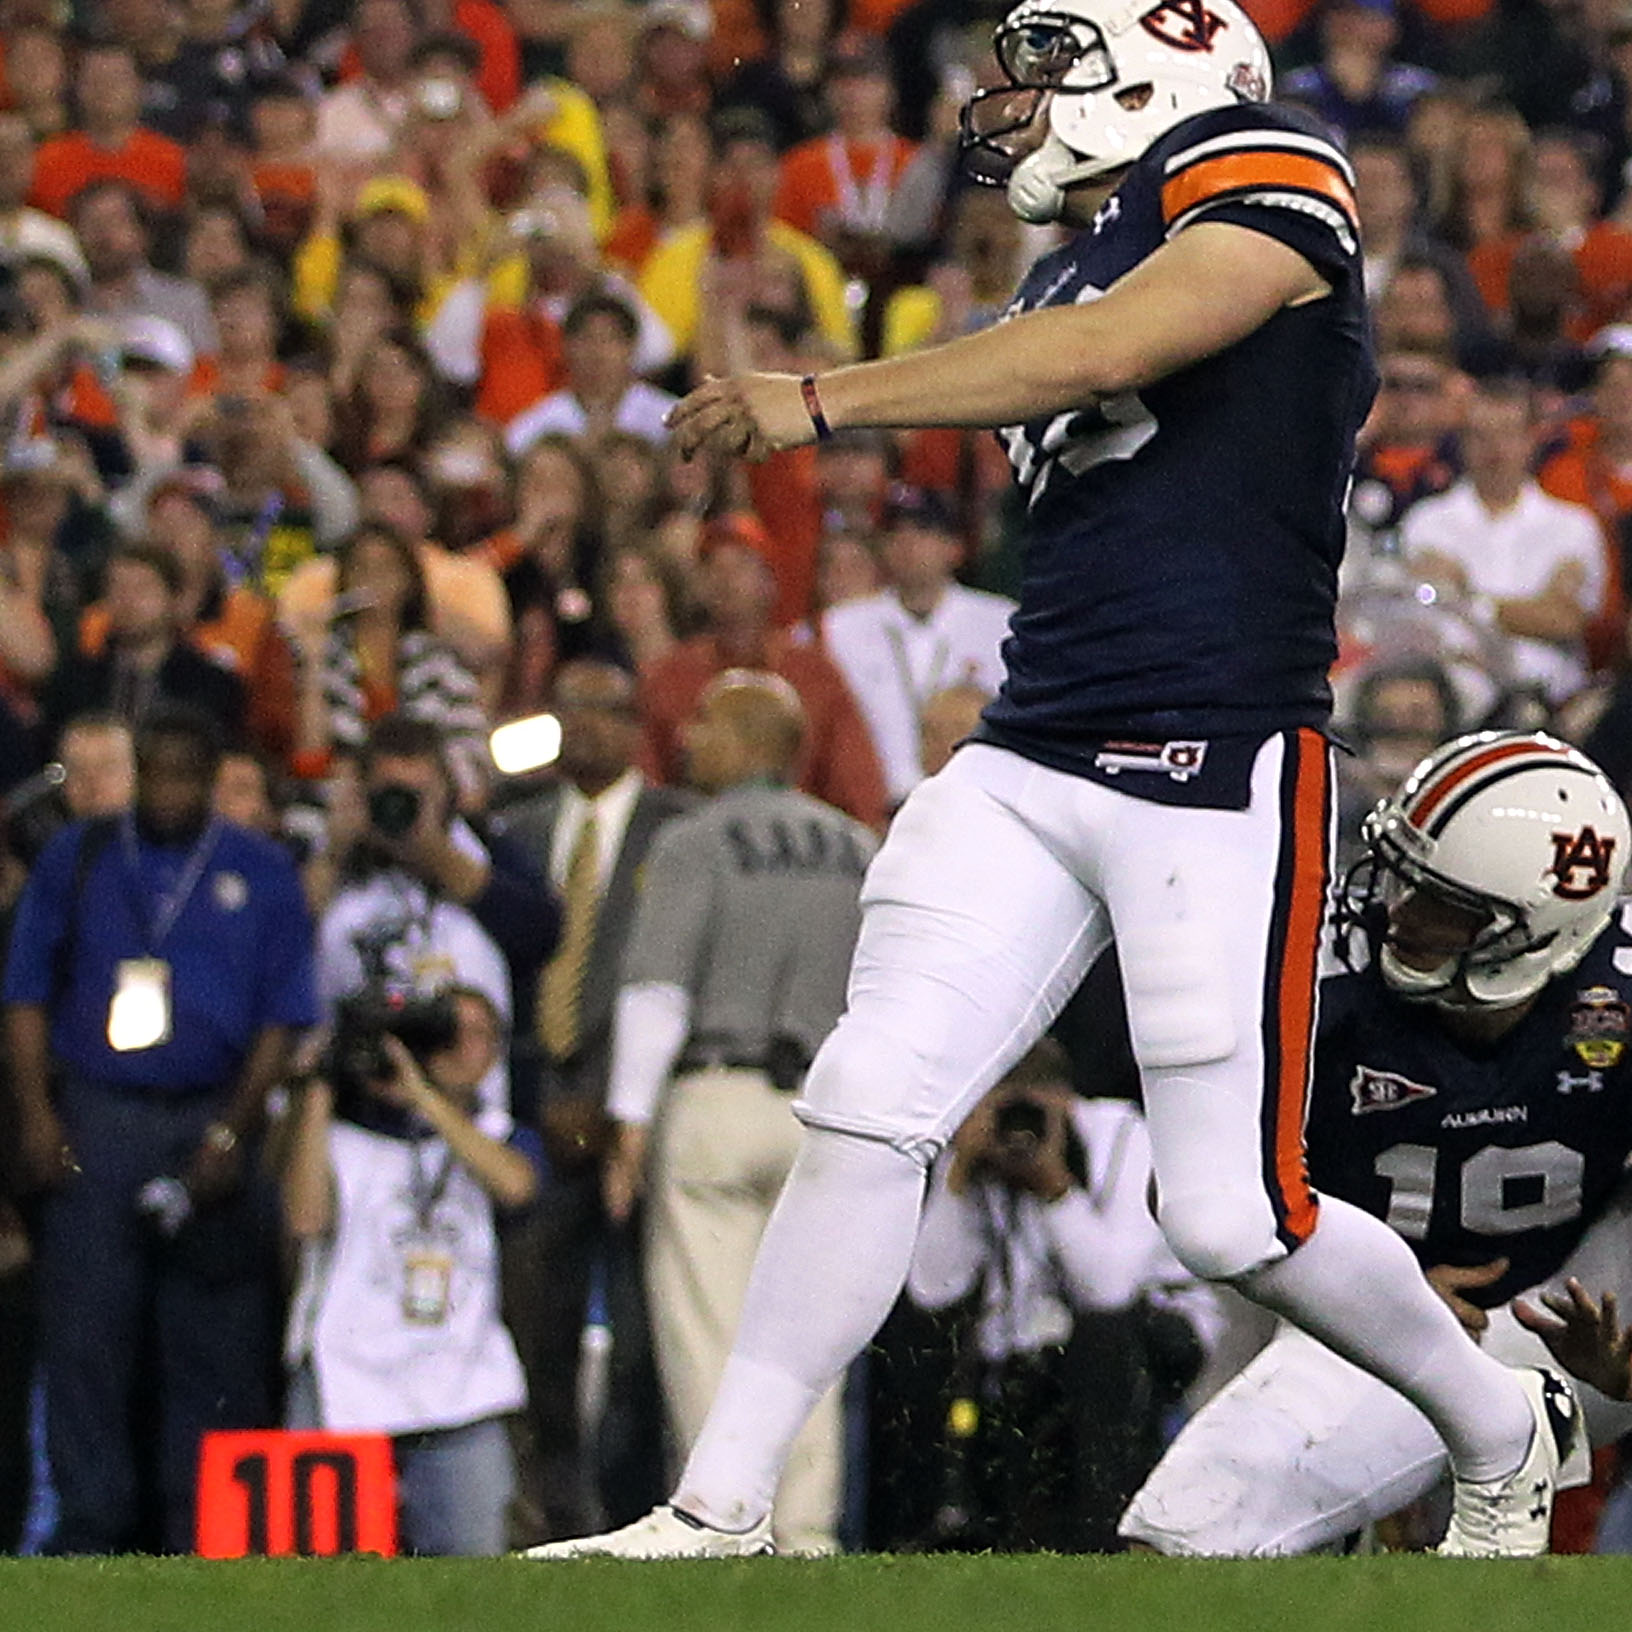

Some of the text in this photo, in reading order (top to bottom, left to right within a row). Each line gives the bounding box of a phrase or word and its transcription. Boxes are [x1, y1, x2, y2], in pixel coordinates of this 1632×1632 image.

[1552, 826, 1615, 900] AU
[1440, 1104, 1529, 1129] AUBURN
[233, 1450, 357, 1556] 10
